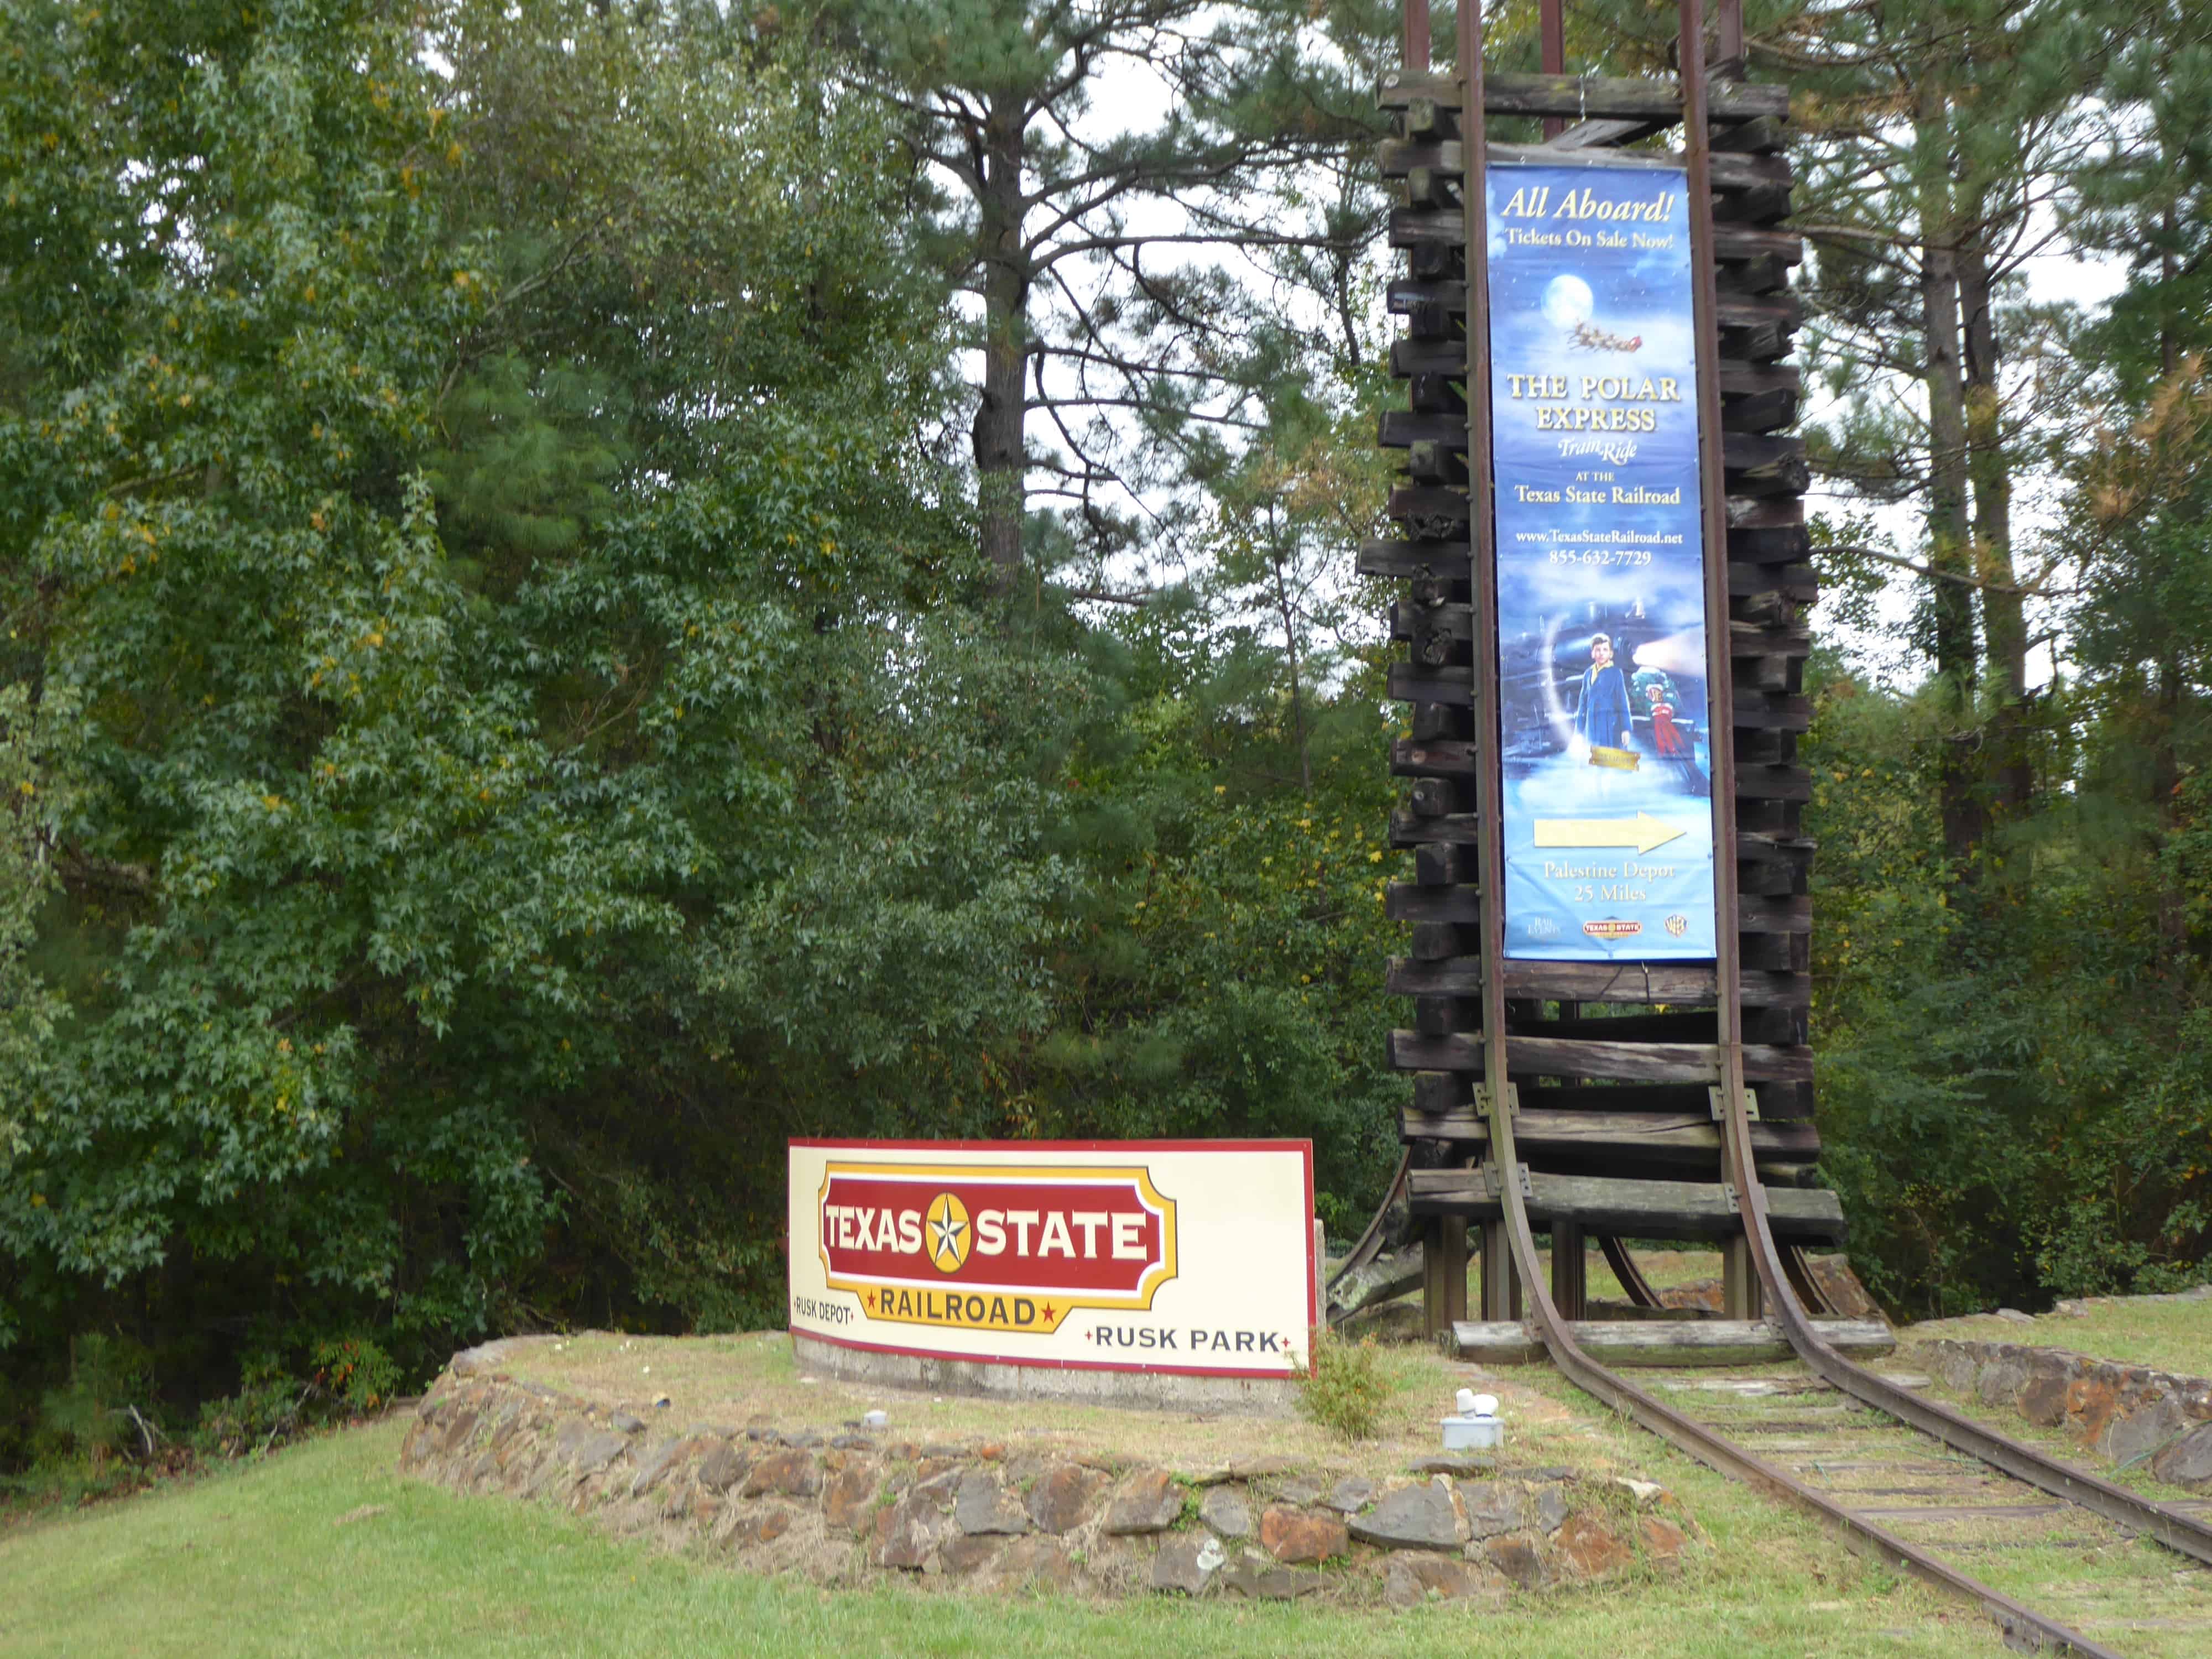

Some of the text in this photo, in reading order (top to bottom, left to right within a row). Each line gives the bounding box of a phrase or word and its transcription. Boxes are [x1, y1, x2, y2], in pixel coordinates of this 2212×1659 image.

[1500, 186, 1675, 222] All Aboard!
[1505, 227, 1673, 249] Tickets On Sale Now!
[1507, 374, 1681, 401] THE POLAR
[1536, 406, 1656, 431] EXPRESS
[1558, 436, 1637, 466] Train Ride
[1576, 471, 1614, 482] AT THE
[1514, 484, 1681, 504] Texas State Railroad
[1516, 528, 1683, 544] www.TexasStateRailroad.net
[1549, 550, 1652, 566] 855-632-7729
[1544, 860, 1676, 882] Palestine Depot
[1574, 884, 1647, 901] 25 Miles
[826, 1204, 1147, 1261] TEXAS STATE
[796, 1296, 851, 1325] RUSK DEPOT
[880, 1288, 1035, 1326] RAILROAD
[1096, 1326, 1280, 1352] RUSK PARK
